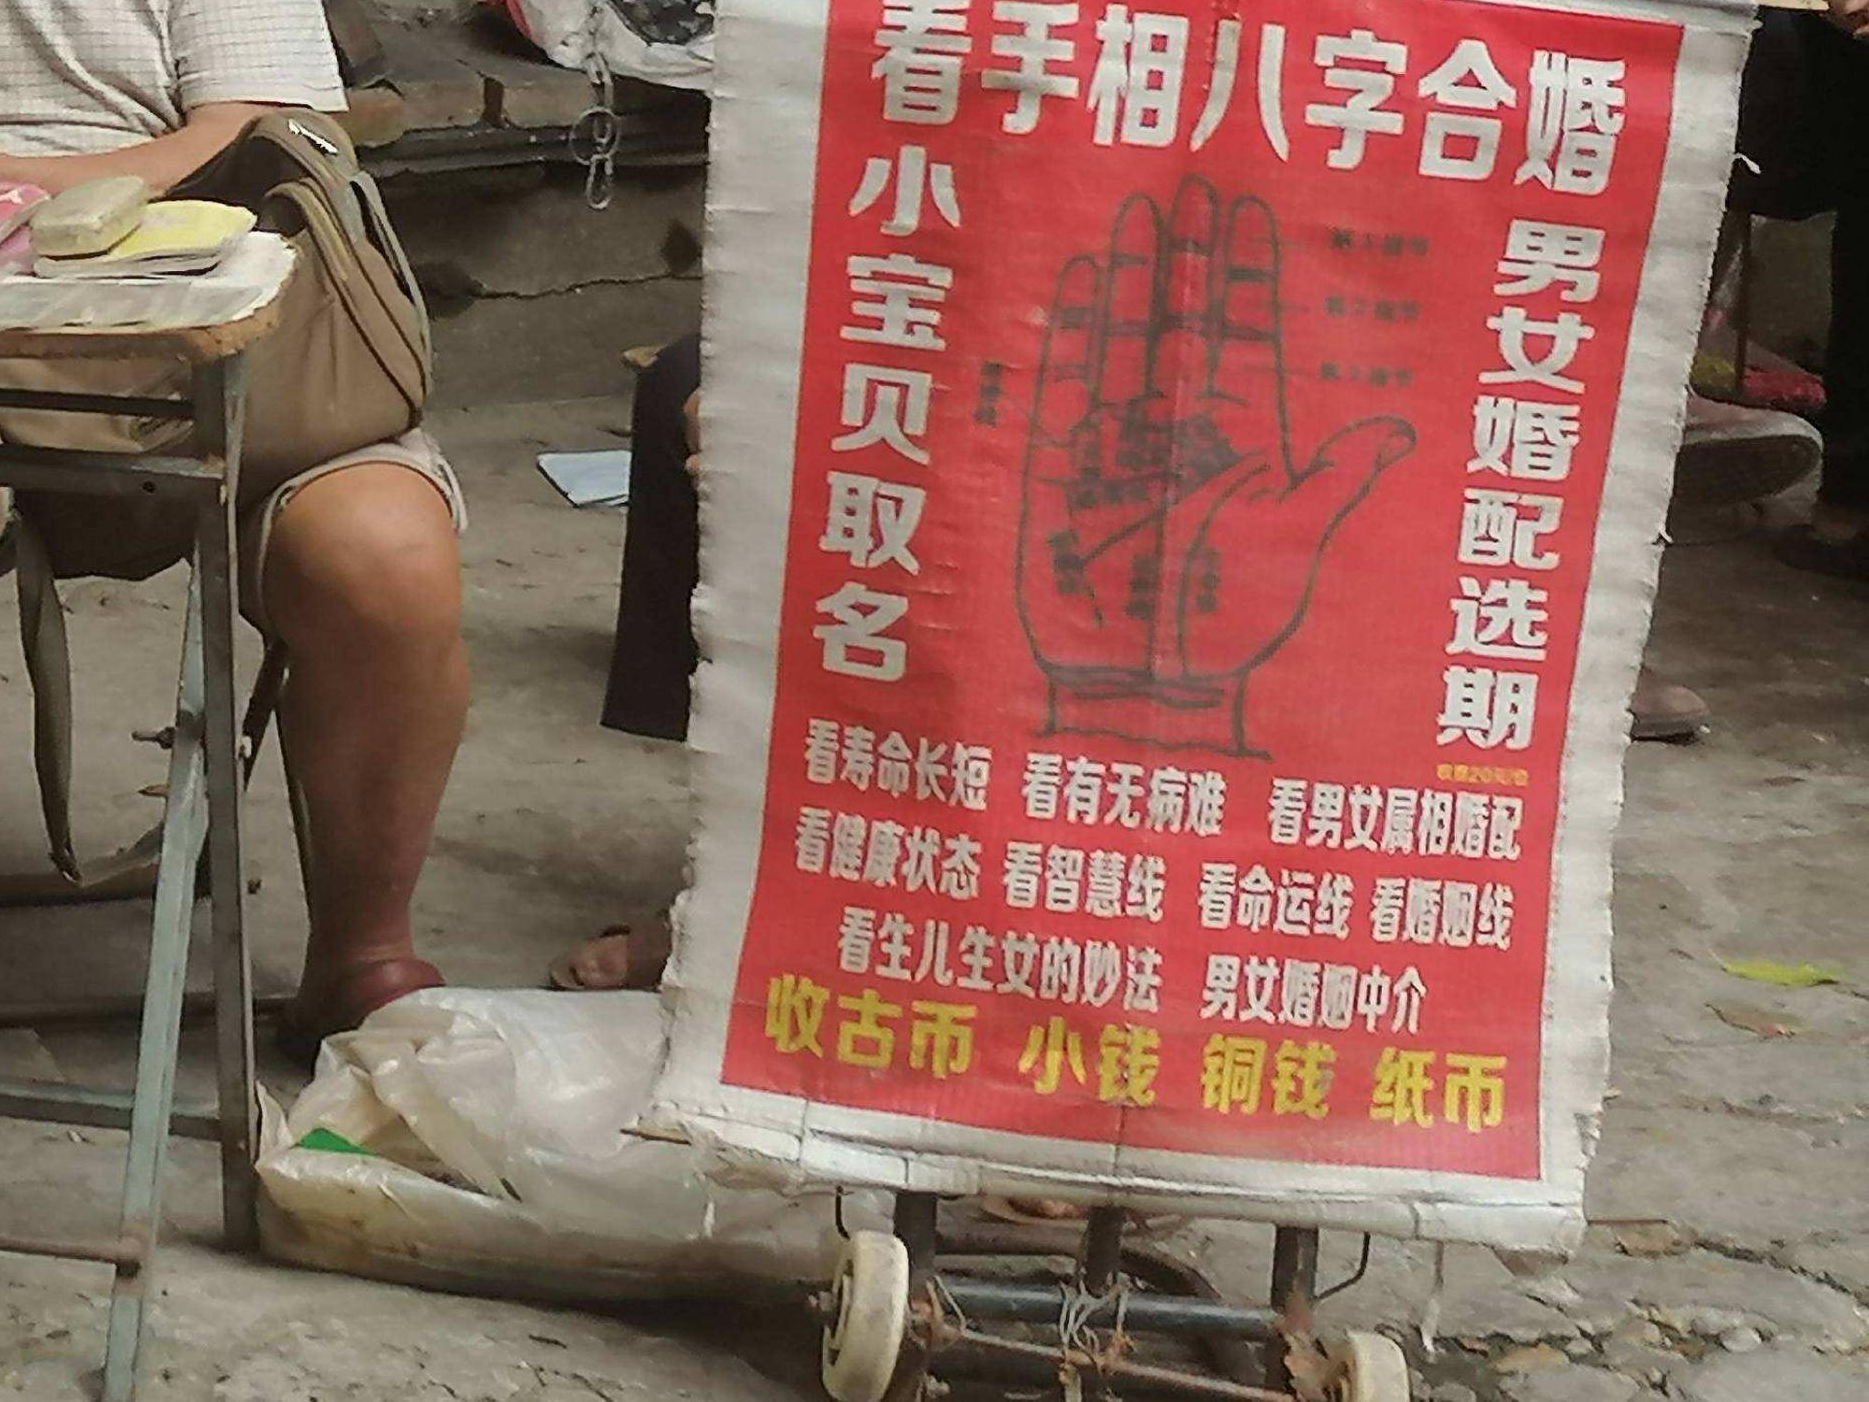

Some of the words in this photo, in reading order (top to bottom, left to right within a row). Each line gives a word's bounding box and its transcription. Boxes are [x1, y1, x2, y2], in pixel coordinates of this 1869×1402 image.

[811, 145, 964, 684] 小宝贝取名
[1435, 218, 1608, 750] 男女婚配选期
[803, 717, 993, 811] 看寿命长短
[1022, 751, 1227, 837] 看有无病难
[1267, 775, 1524, 861] 看男女属相婚配
[795, 805, 981, 899] 看健康状态
[1003, 840, 1167, 923] 看智慧线
[1198, 861, 1355, 940] 看命运线
[1369, 877, 1515, 951] 看婚姻线
[837, 905, 1164, 1013] 看生儿生女的妙法
[1200, 953, 1428, 1034] 男女婚姻中介
[764, 973, 979, 1080] 收古币
[1017, 1015, 1161, 1107] 小钱
[1200, 1032, 1337, 1117] 铜钱
[1369, 1045, 1508, 1133] 纸币
